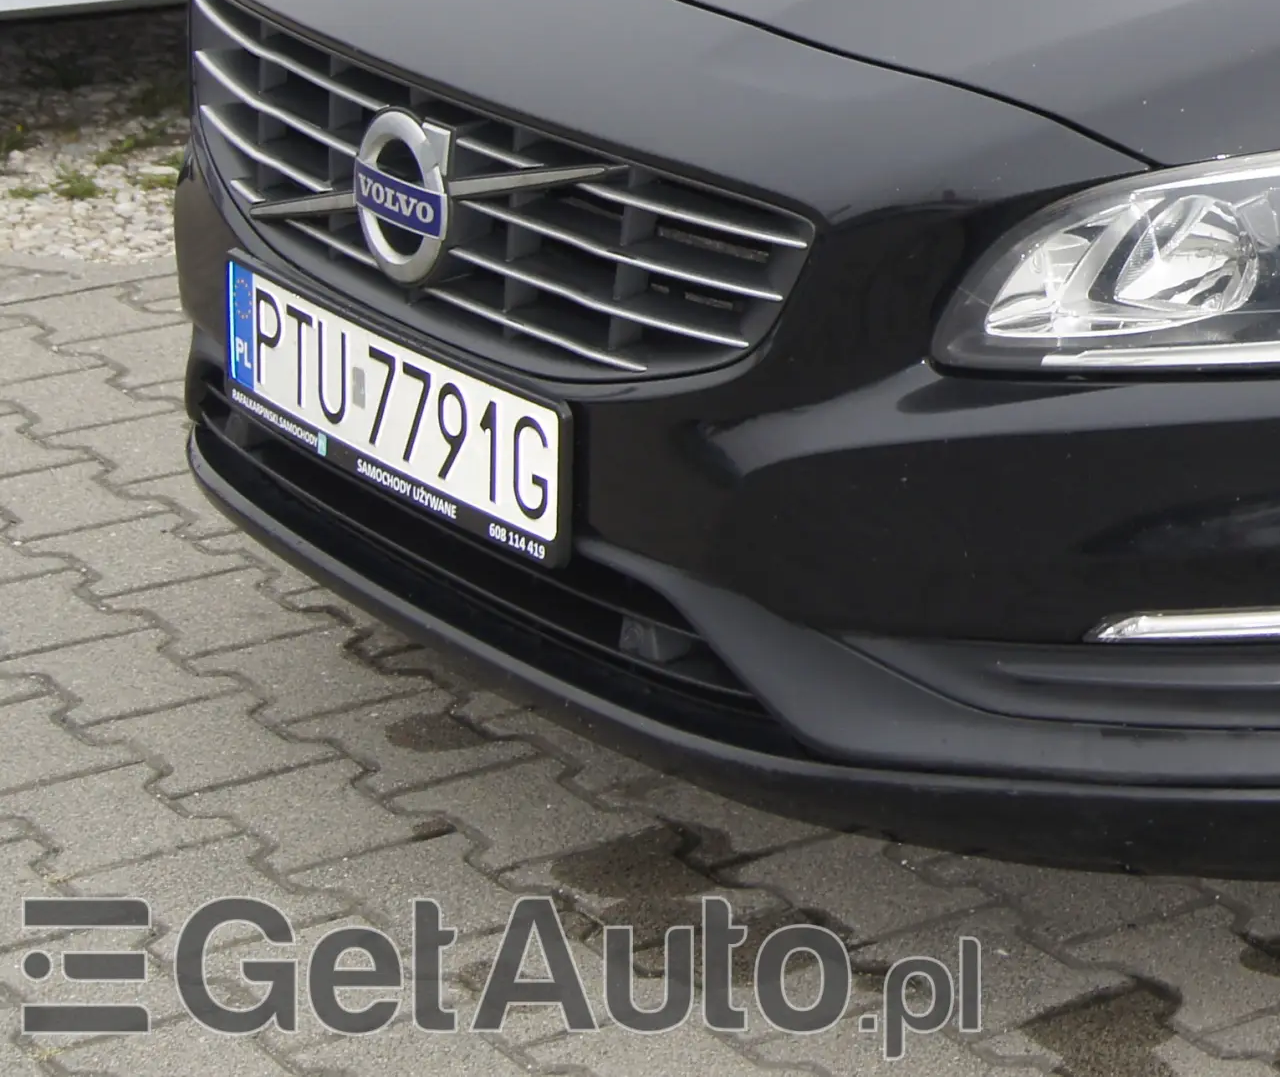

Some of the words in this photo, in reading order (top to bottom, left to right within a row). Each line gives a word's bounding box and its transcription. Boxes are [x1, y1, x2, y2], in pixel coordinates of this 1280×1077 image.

[358, 172, 435, 224] VOLVO
[235, 338, 252, 369] PL
[255, 286, 346, 425] PTU
[368, 345, 550, 521] 7791G
[356, 458, 412, 497] SAMOCHODY
[412, 485, 457, 519] UŻYWANE
[489, 522, 507, 543] 608
[508, 530, 526, 551] 114
[527, 537, 546, 560] 419
